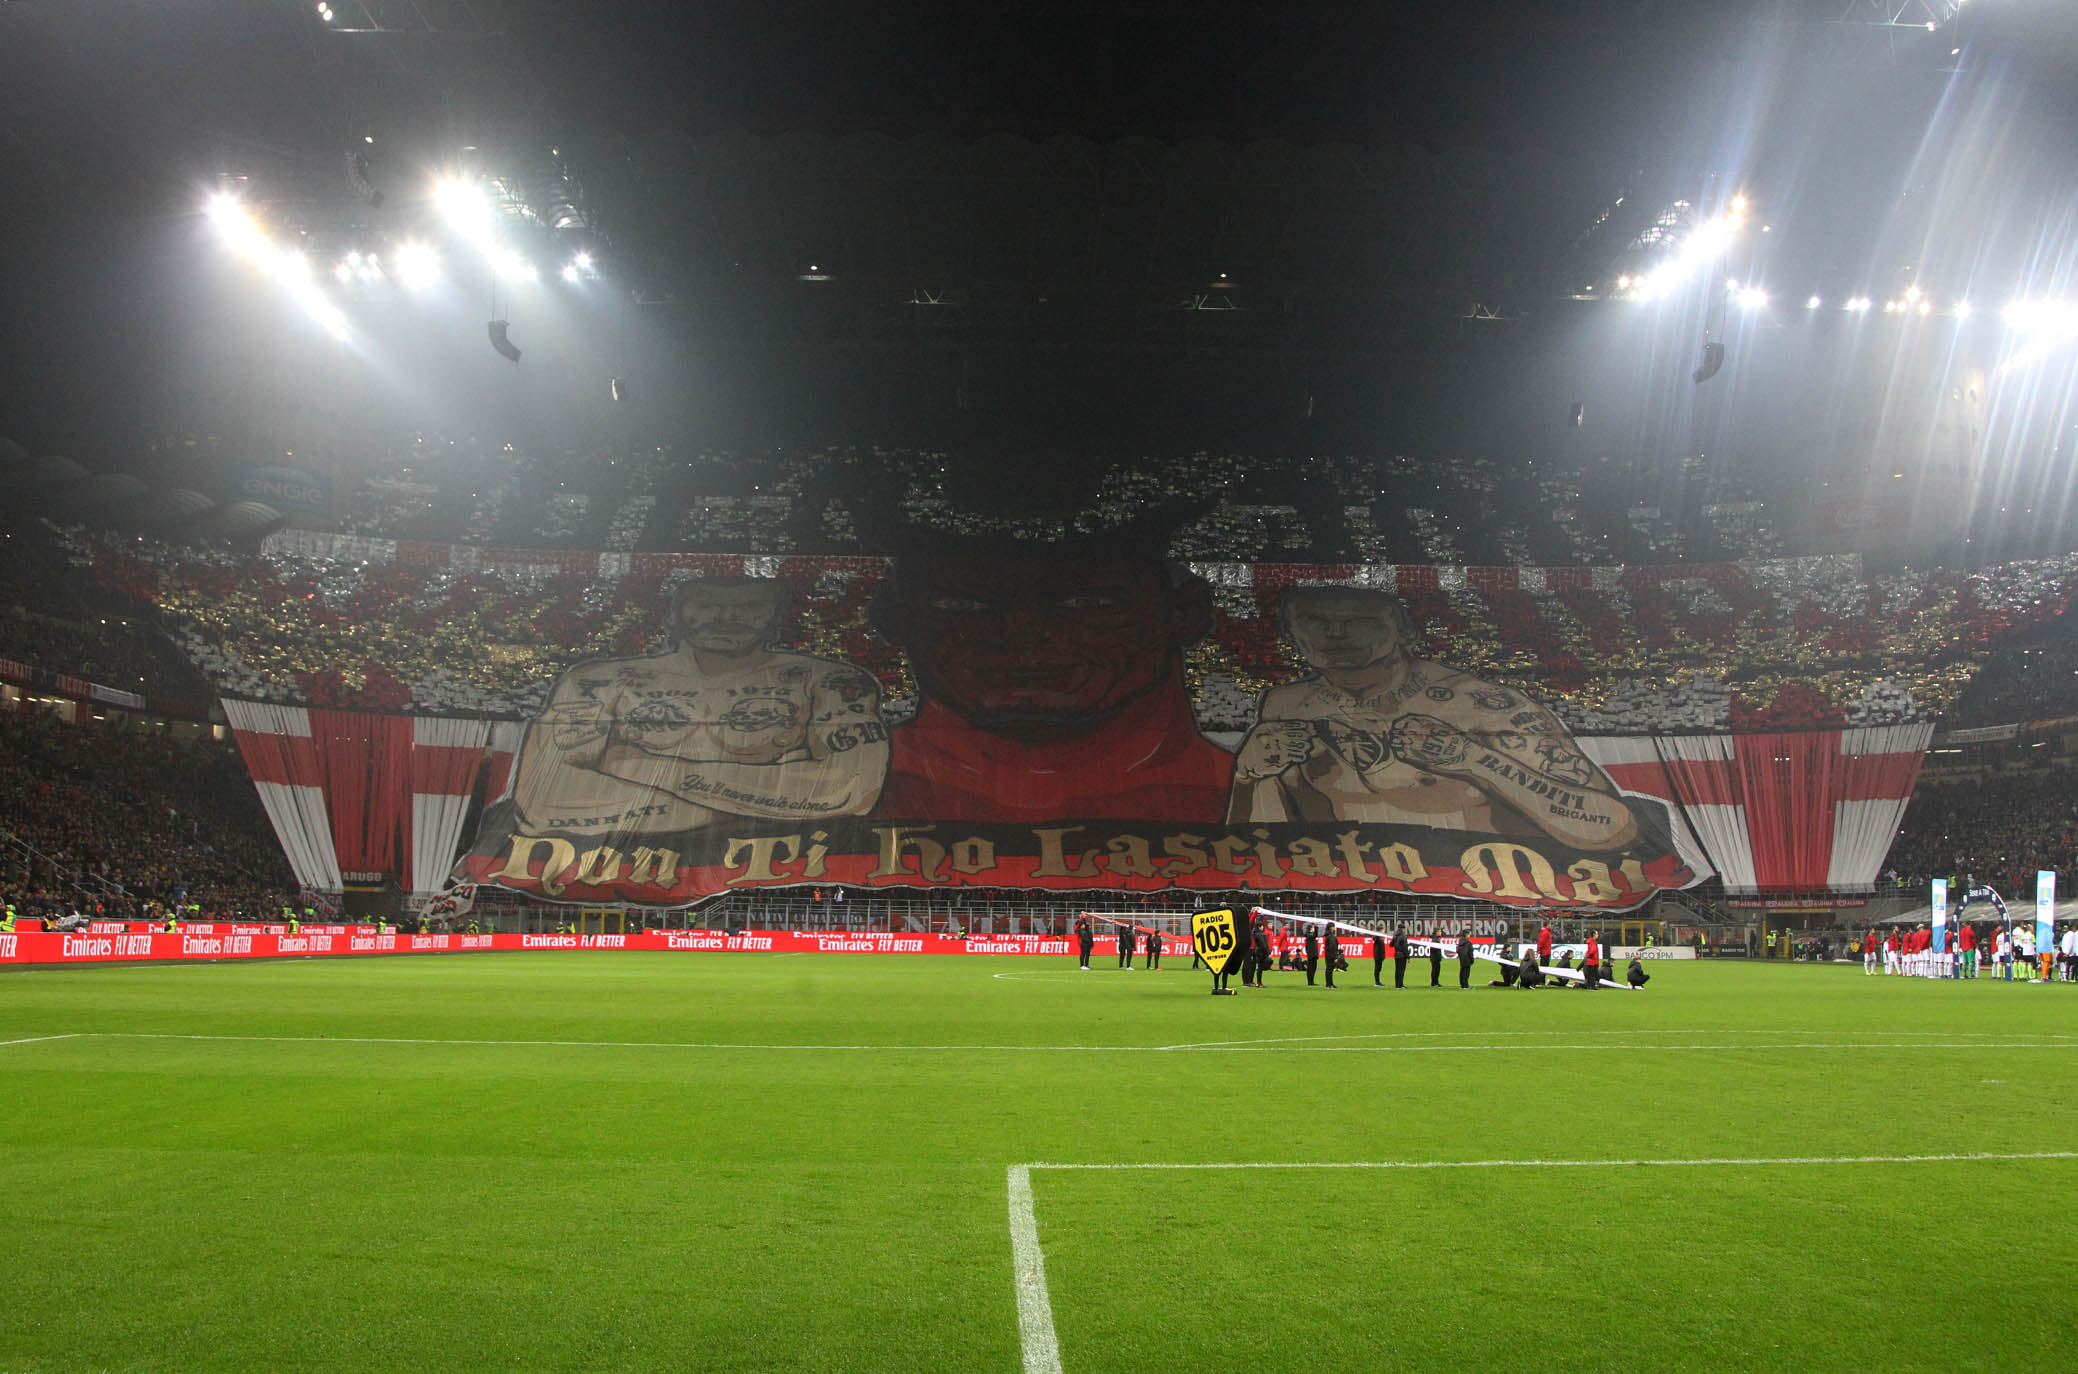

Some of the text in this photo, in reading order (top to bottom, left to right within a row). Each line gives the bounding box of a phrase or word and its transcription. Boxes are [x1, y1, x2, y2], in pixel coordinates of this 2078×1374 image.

[1478, 754, 1585, 810] BANDITI
[789, 798, 830, 812] alone
[1550, 804, 1612, 824] BRIGANTI
[723, 830, 829, 886] Ti
[1028, 825, 1431, 884] Lasciato
[1460, 842, 1656, 903] Mai
[1200, 915, 1224, 925] RADIO
[64, 936, 152, 957] Emirates FLY BETTER
[184, 936, 252, 955] Emirates FLY BETTER
[523, 936, 626, 948] Emirates FLY BETTER
[668, 936, 772, 950] Emirates FLY BETTER
[820, 938, 923, 952] Emirates FLY BETTER
[1196, 924, 1234, 954] 105
[966, 941, 1069, 954] Emirates FLY BETTER
